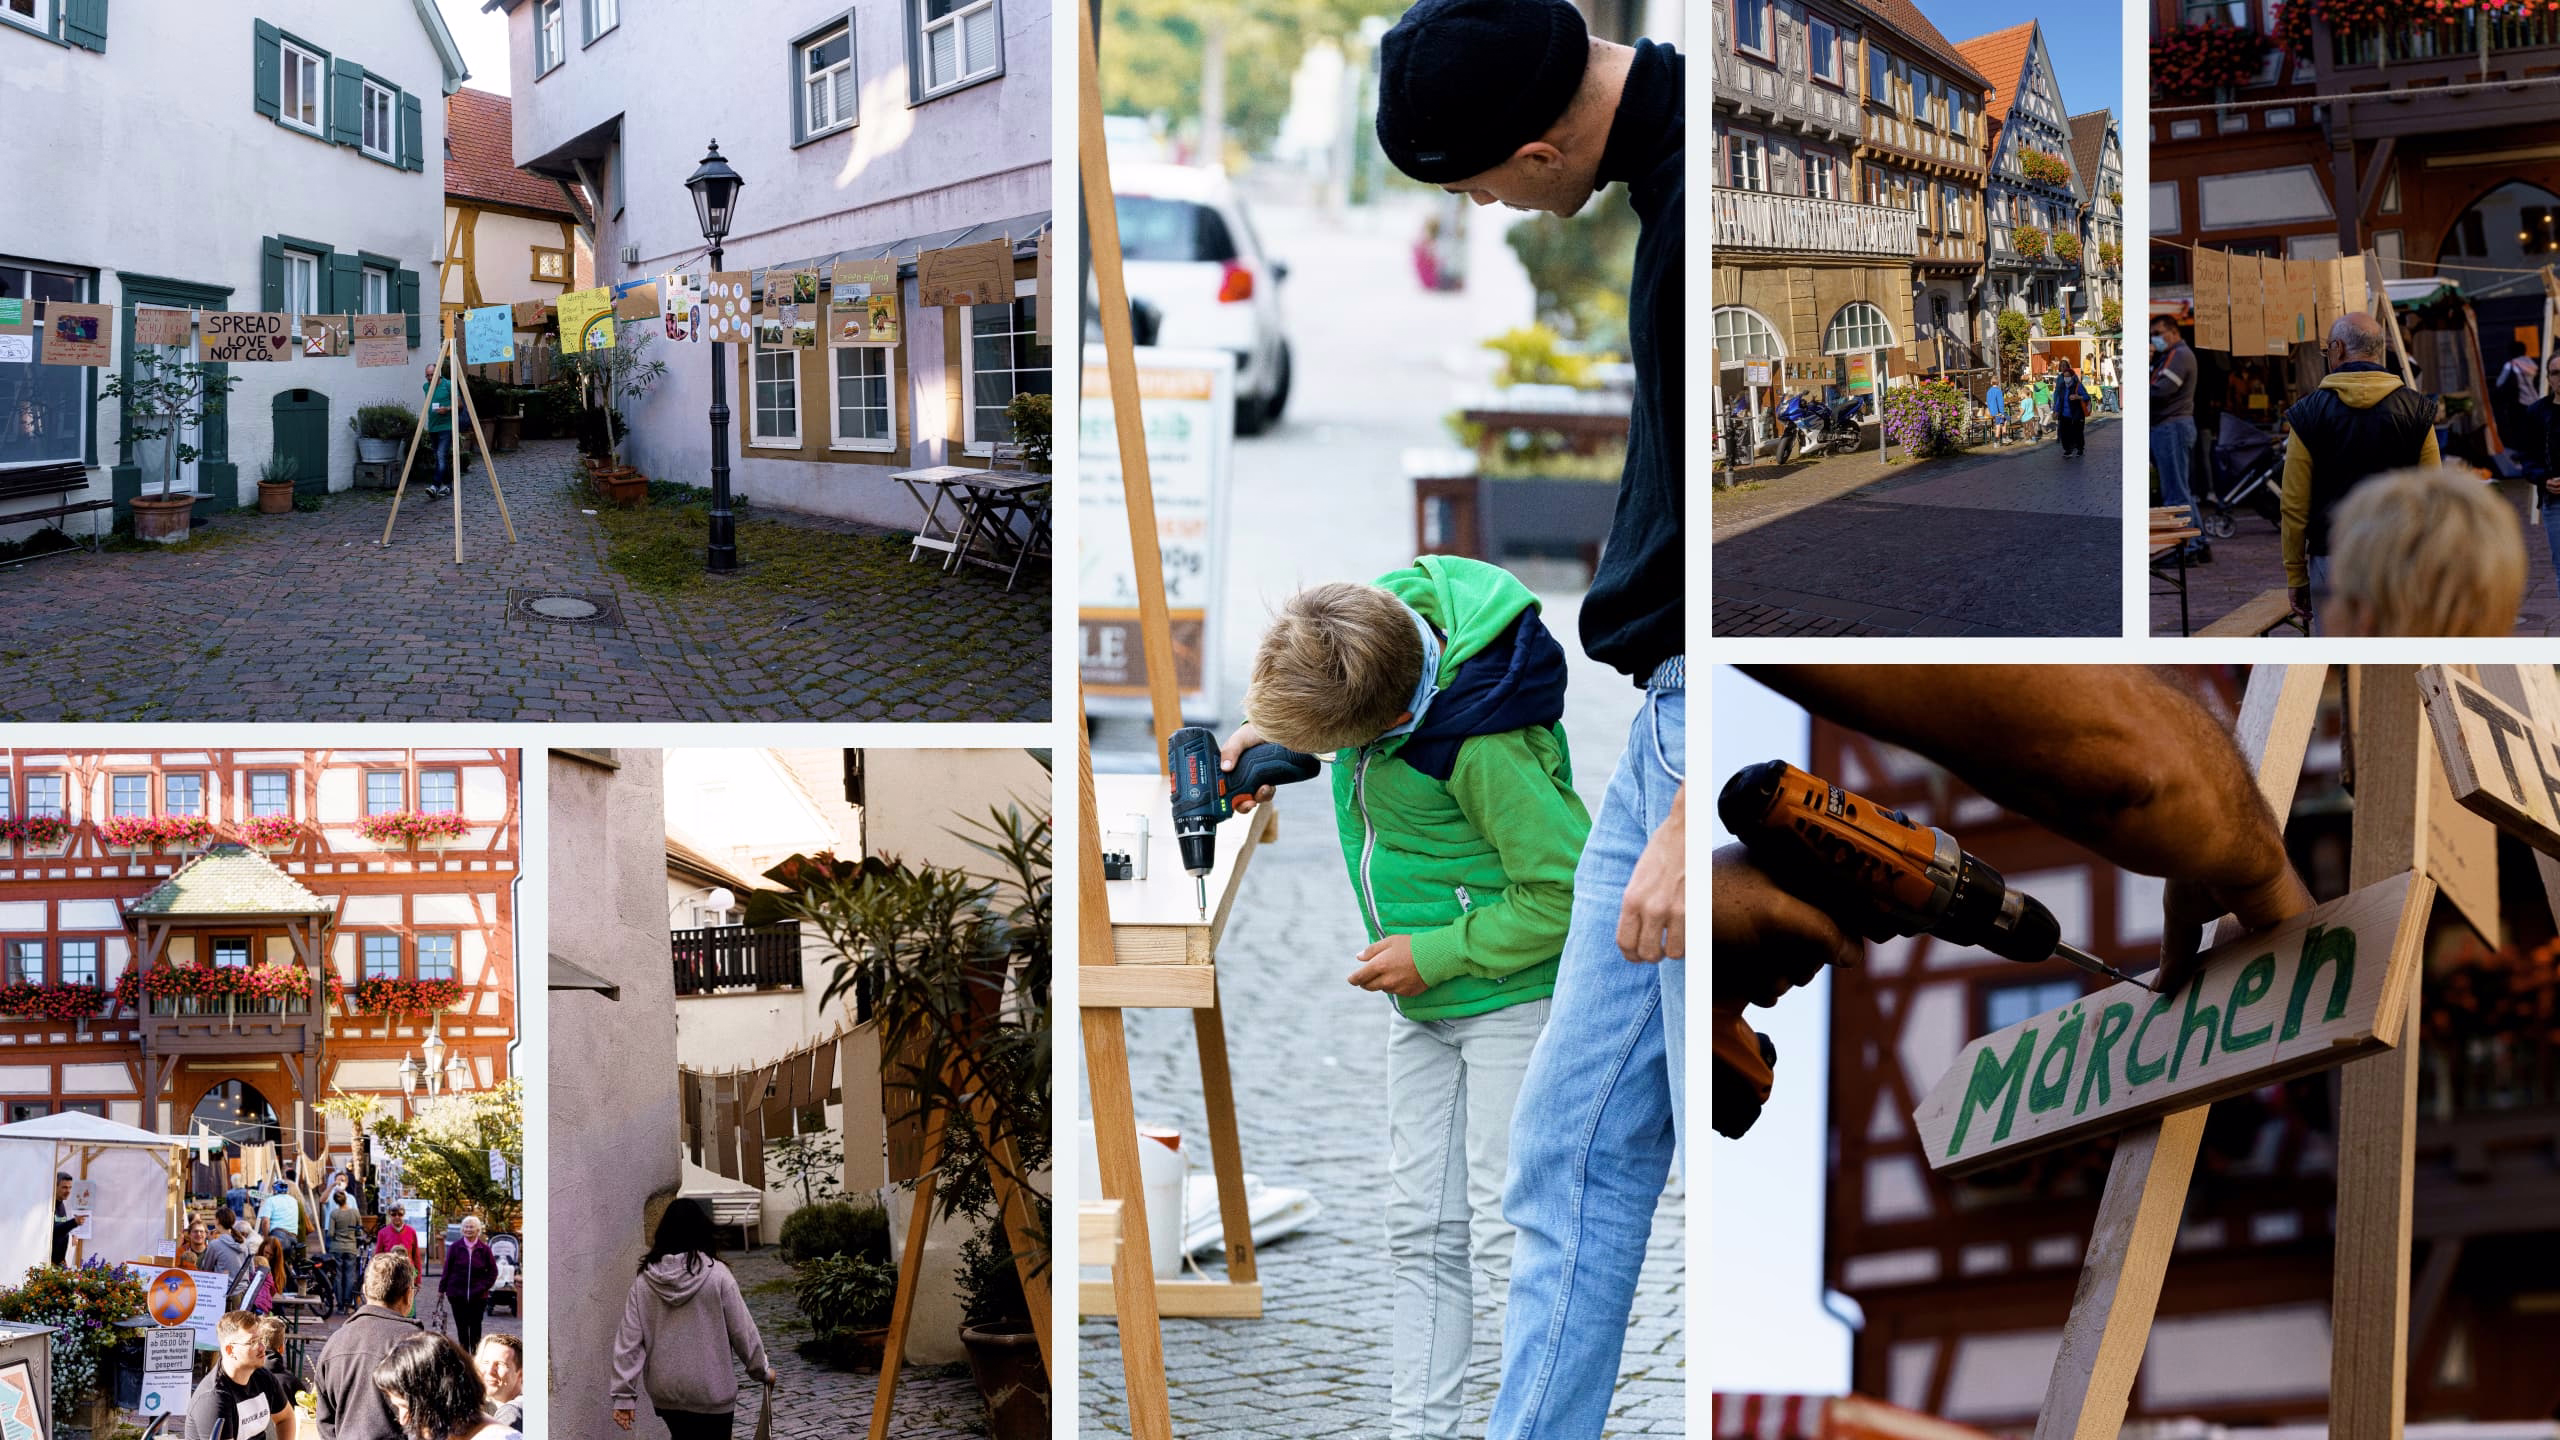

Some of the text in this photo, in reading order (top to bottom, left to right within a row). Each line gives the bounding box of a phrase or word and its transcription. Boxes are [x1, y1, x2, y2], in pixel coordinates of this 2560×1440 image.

[835, 264, 862, 283] Green
[208, 316, 281, 334] SPREAD
[227, 335, 267, 349] LOVE
[210, 346, 241, 361] NOT
[1188, 755, 1199, 785] BOSCH
[155, 1331, 187, 1339] Samstags
[154, 1361, 183, 1370] gesperrt
